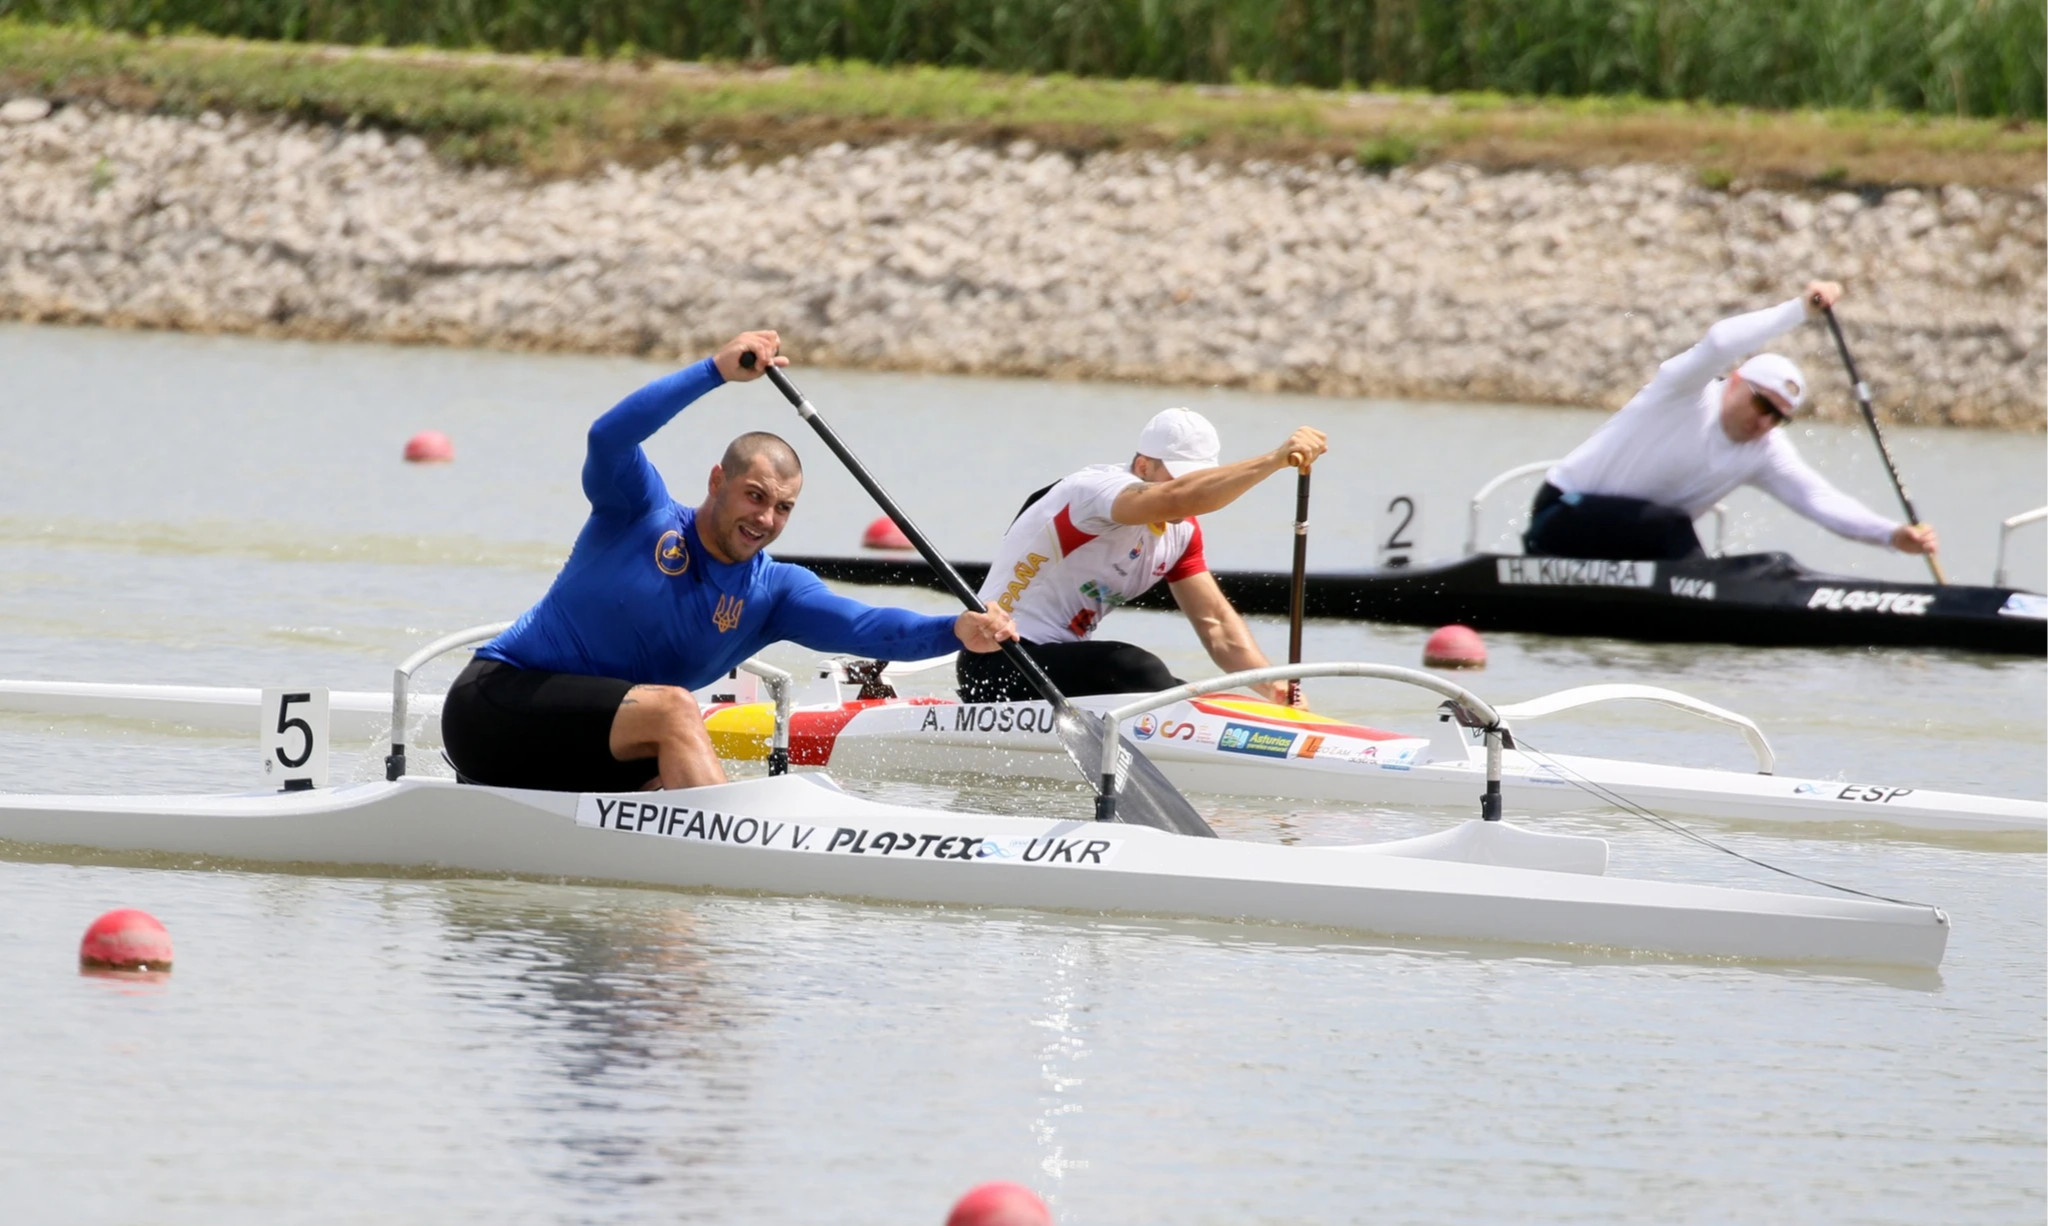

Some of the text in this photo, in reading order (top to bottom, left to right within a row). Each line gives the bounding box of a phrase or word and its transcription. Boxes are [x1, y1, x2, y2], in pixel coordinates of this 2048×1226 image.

[1387, 496, 1414, 549] 2
[998, 553, 1049, 612] PAÑA
[1509, 559, 1638, 585] H. KUZURA
[275, 692, 314, 769] 5
[920, 705, 1055, 734] A. MOSQU
[1249, 732, 1292, 746] Asturias
[1836, 784, 1913, 803] ESP
[596, 798, 783, 846] YEPIFANOV
[791, 826, 811, 850] V.
[1022, 838, 1111, 864] UKR
